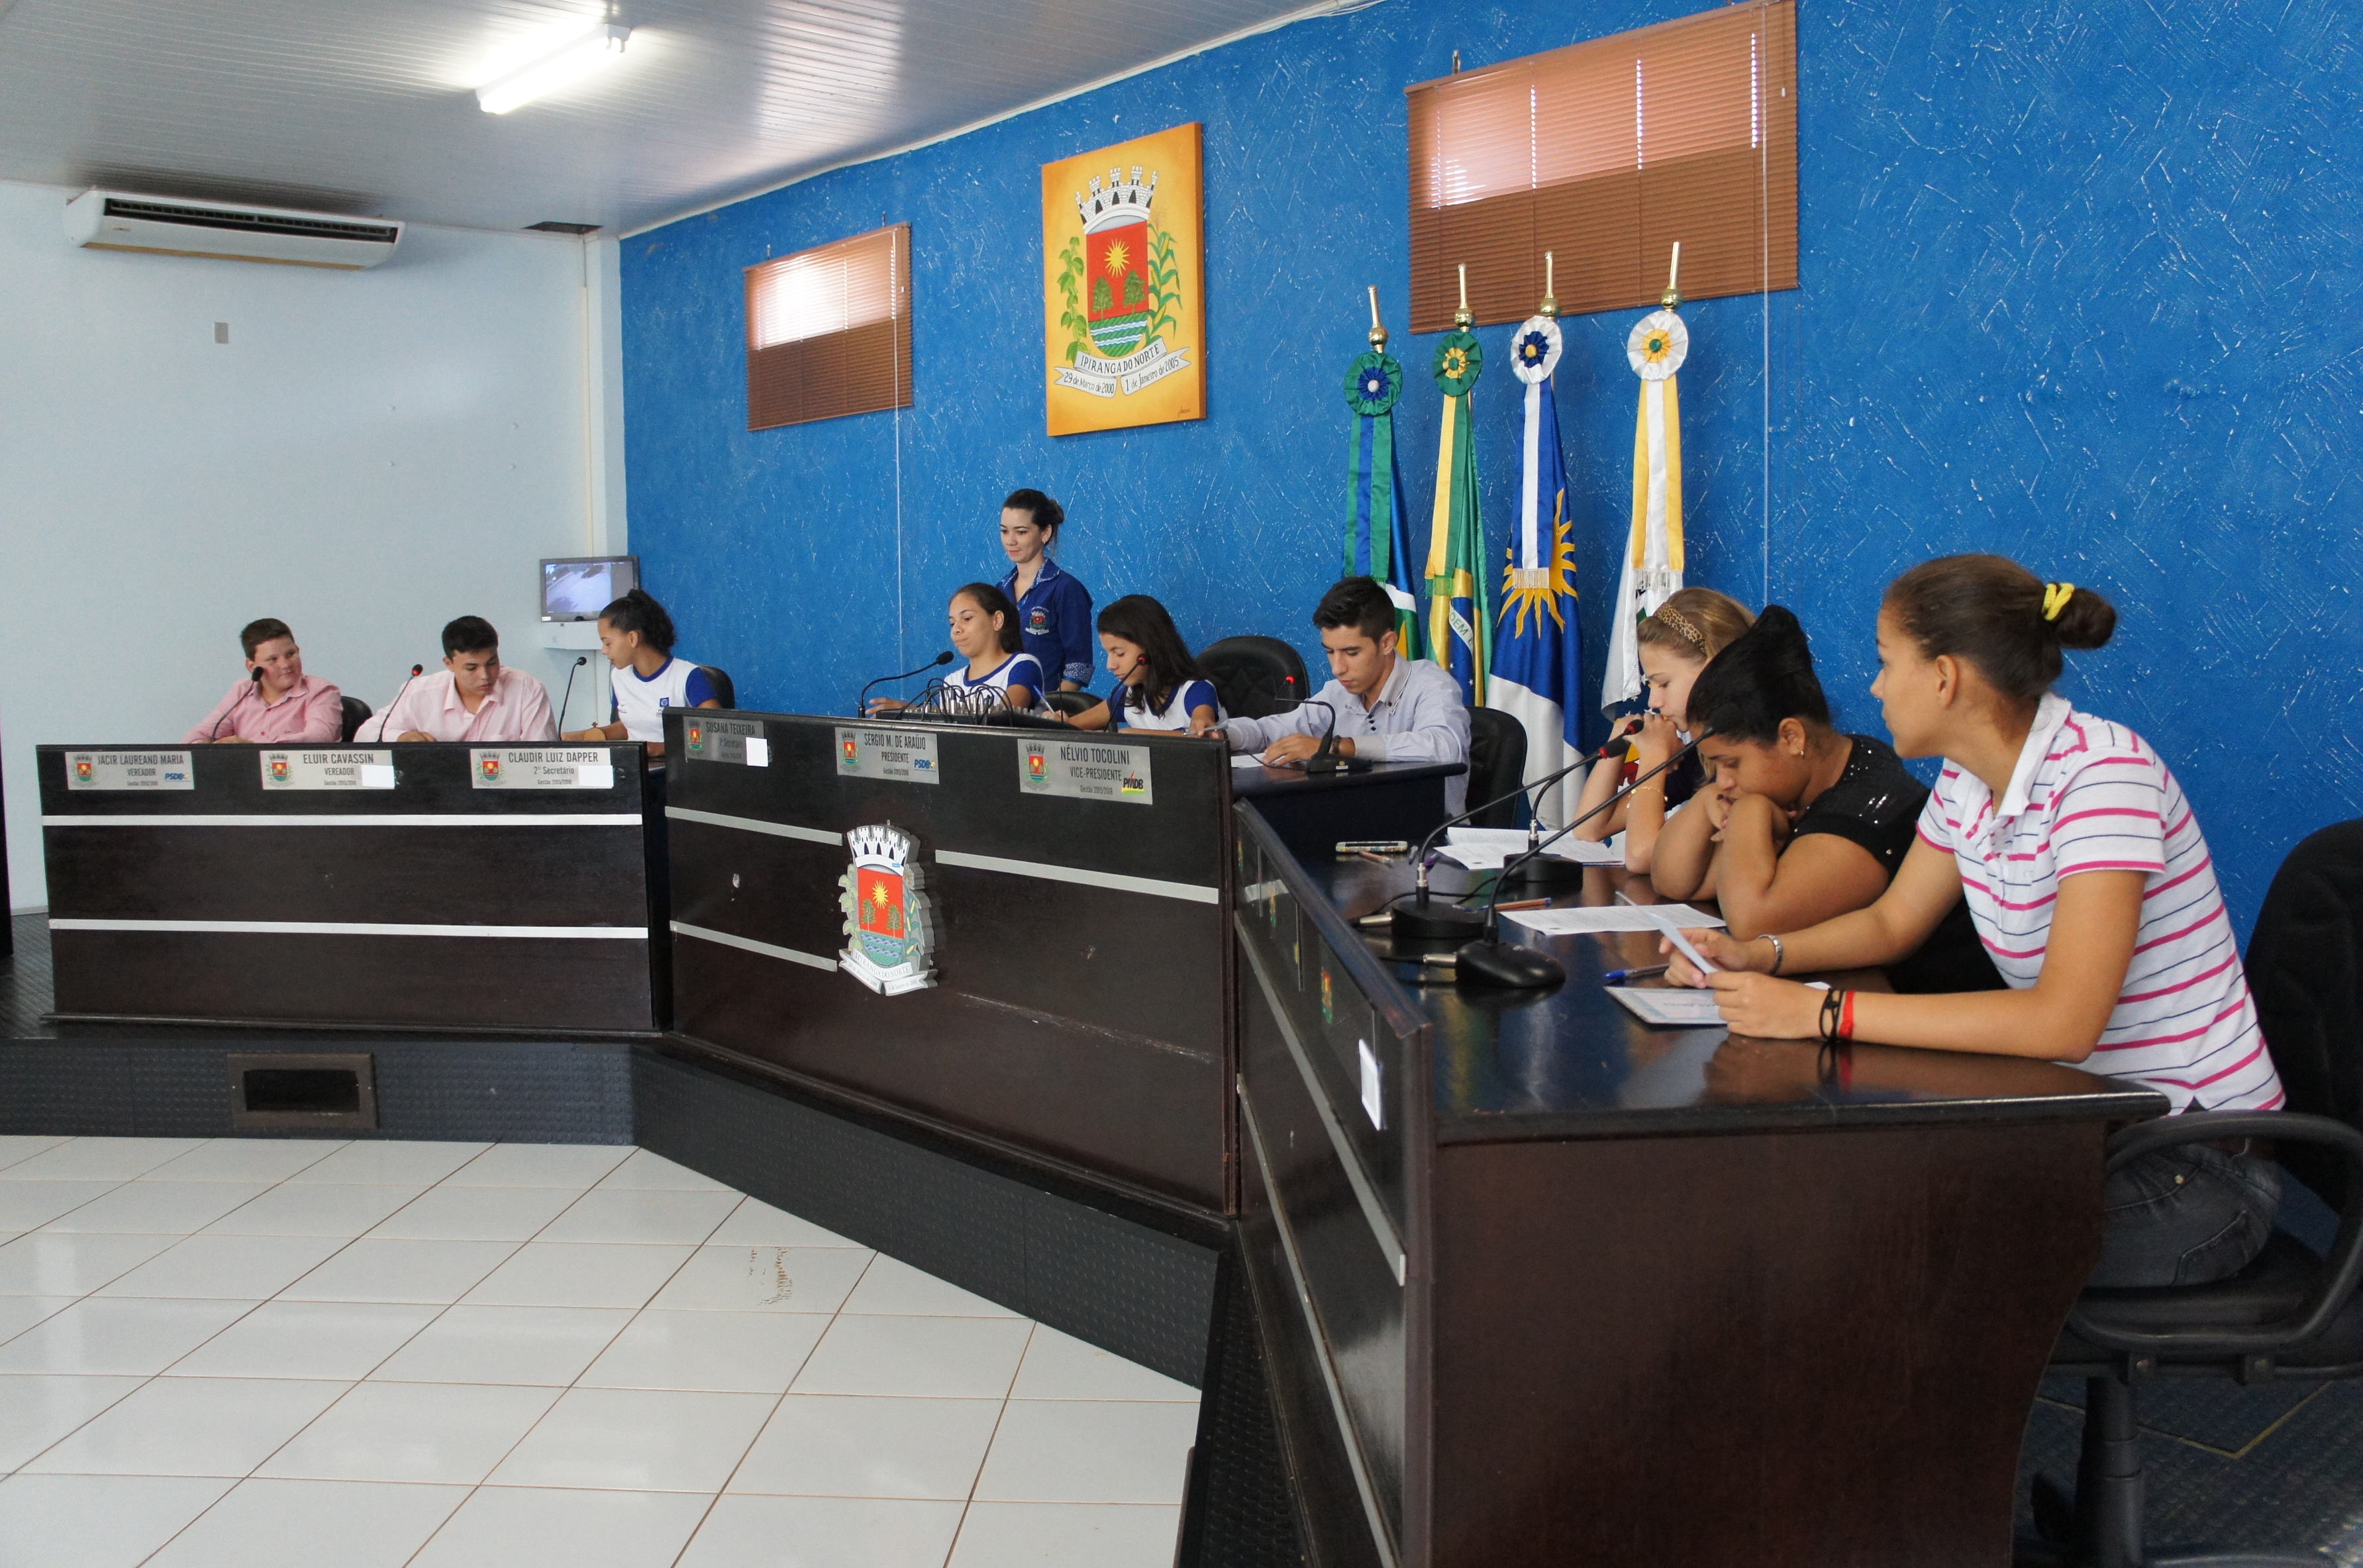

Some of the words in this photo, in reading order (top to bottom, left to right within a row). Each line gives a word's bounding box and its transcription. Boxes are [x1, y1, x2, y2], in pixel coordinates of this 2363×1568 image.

[1080, 355, 1122, 374] IPIRANGA
[1123, 360, 1132, 371] DO
[1133, 343, 1160, 368] NORTE
[1131, 379, 1138, 387] de
[1138, 370, 1158, 390] Janeiro
[1158, 365, 1165, 375] de
[1164, 356, 1180, 372] 2005
[1064, 372, 1073, 383] 29
[1073, 375, 1080, 385] de
[1080, 378, 1095, 391] Março
[1095, 383, 1101, 393] de
[1101, 382, 1115, 394] 2000
[705, 721, 729, 734] SUSANA
[730, 723, 756, 736] TEIXEIRA
[864, 731, 885, 747] SÉRGIO
[886, 735, 893, 747] M.
[895, 736, 903, 748] DE
[904, 734, 926, 750] ARAÚJO
[98, 755, 117, 765] JACIR
[120, 755, 158, 765] LAUREANO
[160, 754, 184, 765] MARIA
[303, 754, 328, 764] ELUIR
[330, 754, 374, 763] CAVASSIN
[508, 752, 543, 763] CLAUDIR
[546, 752, 564, 762] LUIZ
[566, 752, 599, 762] DAPPER
[881, 752, 909, 763] PRESIDENTE
[1060, 744, 1088, 761] NÉLVIO
[1091, 748, 1130, 765] TOCOLINI
[914, 759, 930, 769] PSDB
[127, 768, 156, 777] VEREADOR
[324, 767, 355, 776] VEREADOR
[543, 766, 575, 775] Secretário
[1070, 767, 1122, 781] VICE-PRESIDENTE
[1123, 777, 1144, 789] PMDB
[855, 952, 881, 978] IPIRANGA
[891, 965, 909, 978] NORTE
